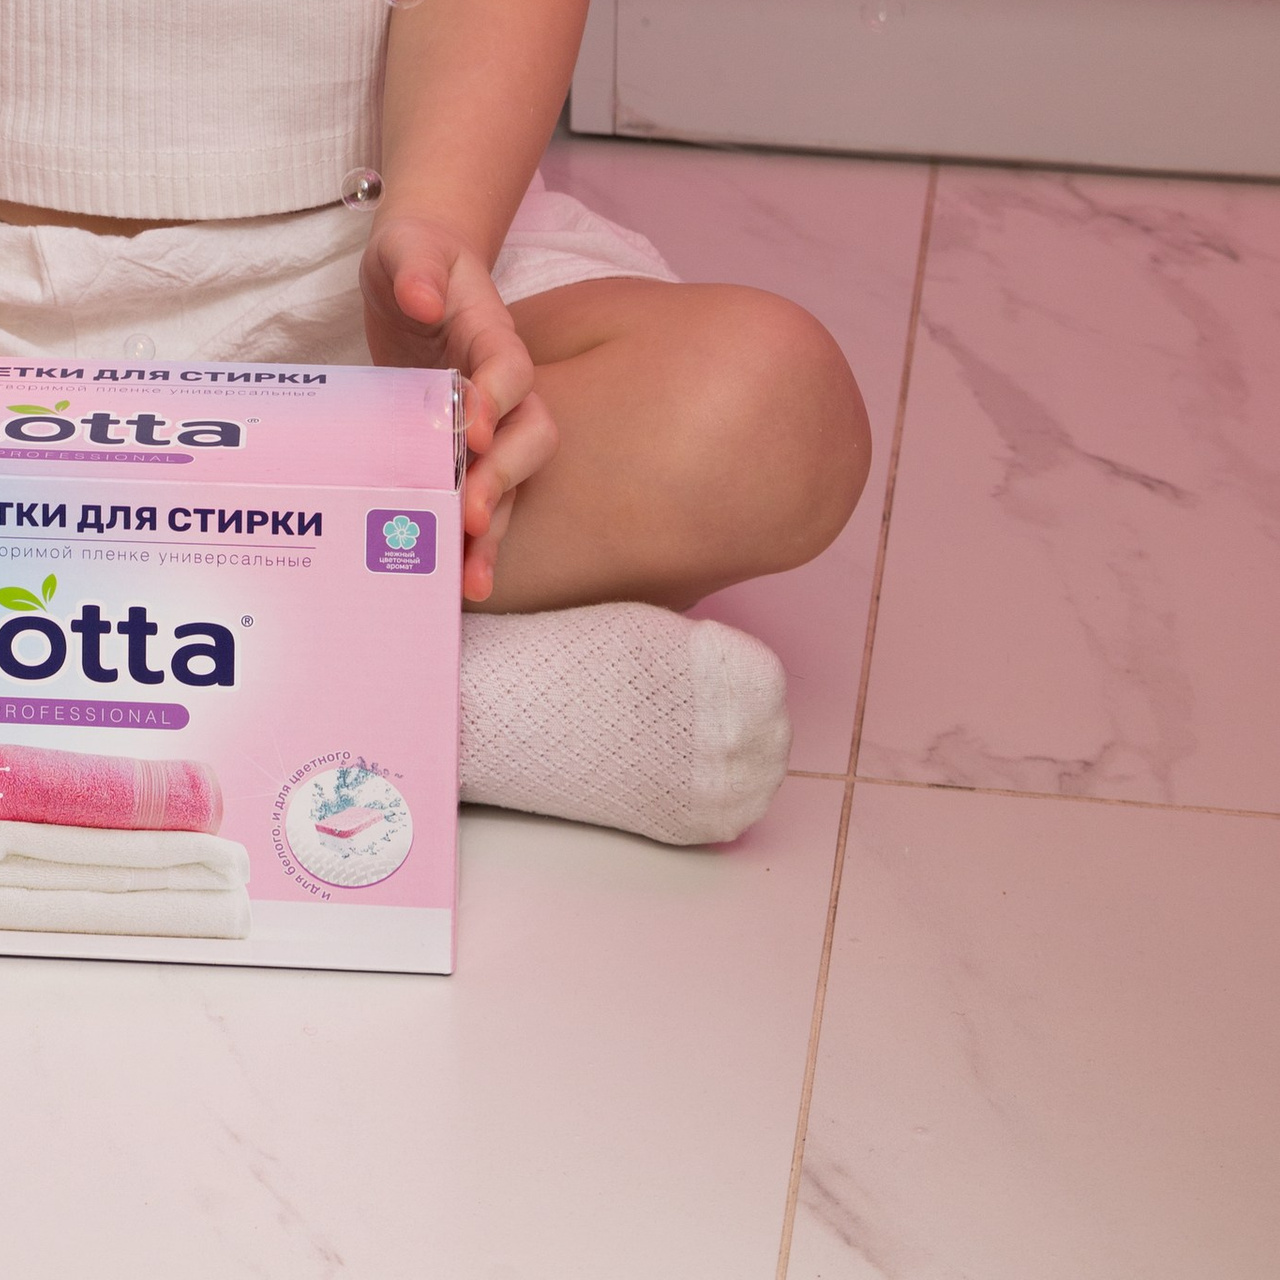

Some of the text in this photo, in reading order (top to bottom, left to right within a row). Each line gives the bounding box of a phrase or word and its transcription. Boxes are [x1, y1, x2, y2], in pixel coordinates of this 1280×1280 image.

[93, 369, 170, 382] ДЛЯ
[180, 371, 327, 385] СТИРКИ
[77, 505, 157, 533] ДЛЯ
[168, 507, 322, 536] СТИРКИ
[82, 548, 150, 561] пленке
[159, 551, 312, 568] универсальные
[289, 751, 351, 785] цветного
[275, 784, 292, 811] для
[272, 812, 281, 821] и
[295, 874, 321, 895] для
[321, 891, 332, 901] и
